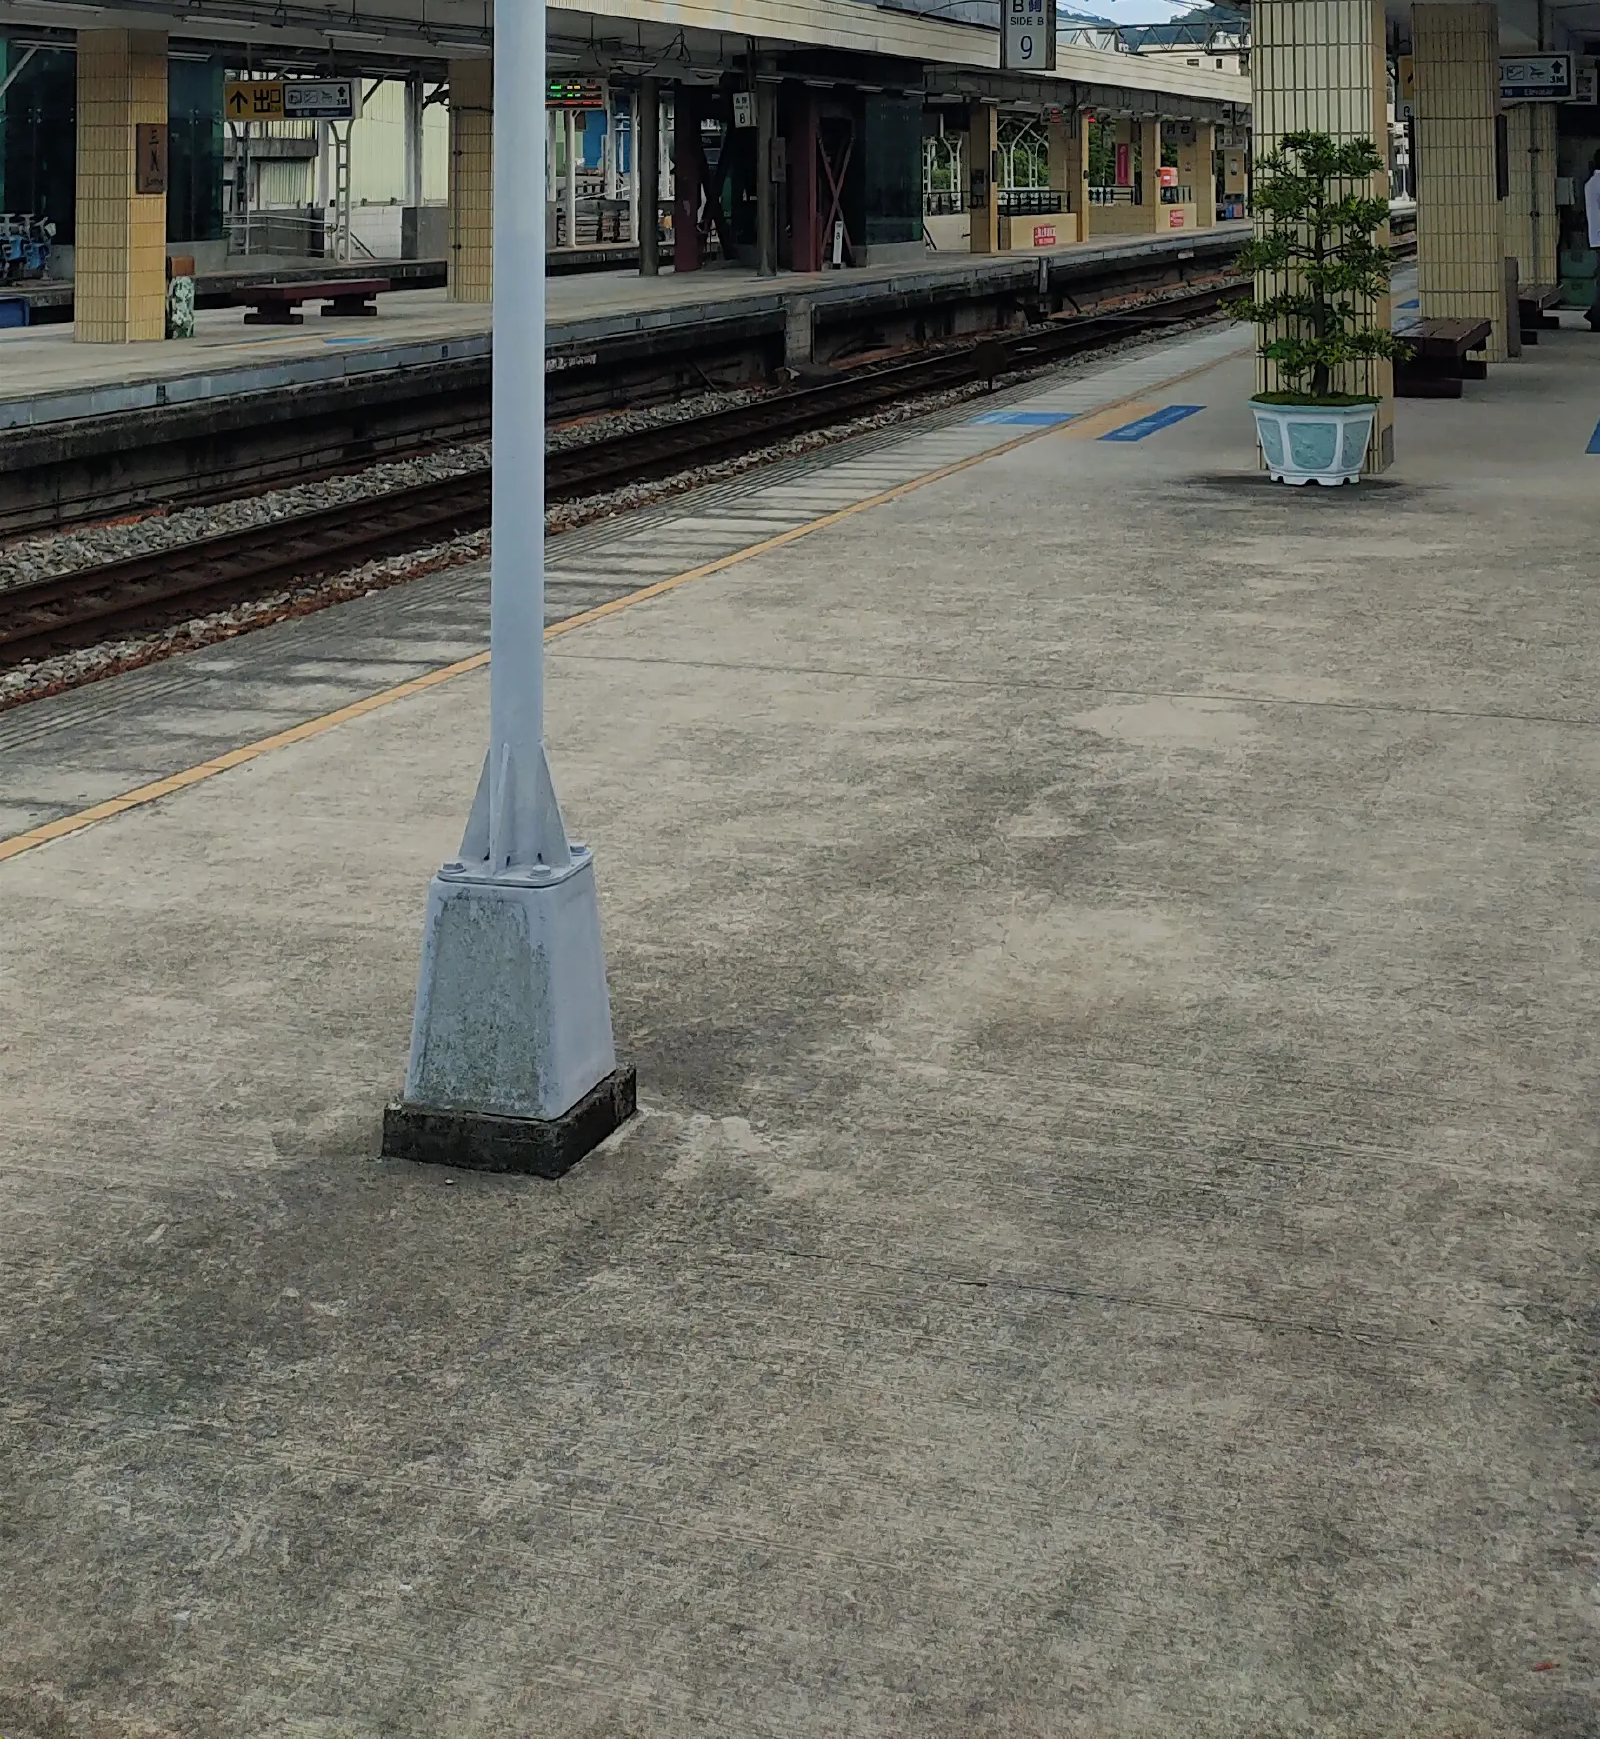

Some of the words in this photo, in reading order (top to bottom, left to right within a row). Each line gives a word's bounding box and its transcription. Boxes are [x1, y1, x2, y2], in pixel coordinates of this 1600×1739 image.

[1010, 16, 1033, 26] SIDE
[1037, 16, 1045, 26] B
[1020, 35, 1033, 60] 9
[253, 89, 281, 113] 出口
[740, 112, 745, 124] 8
